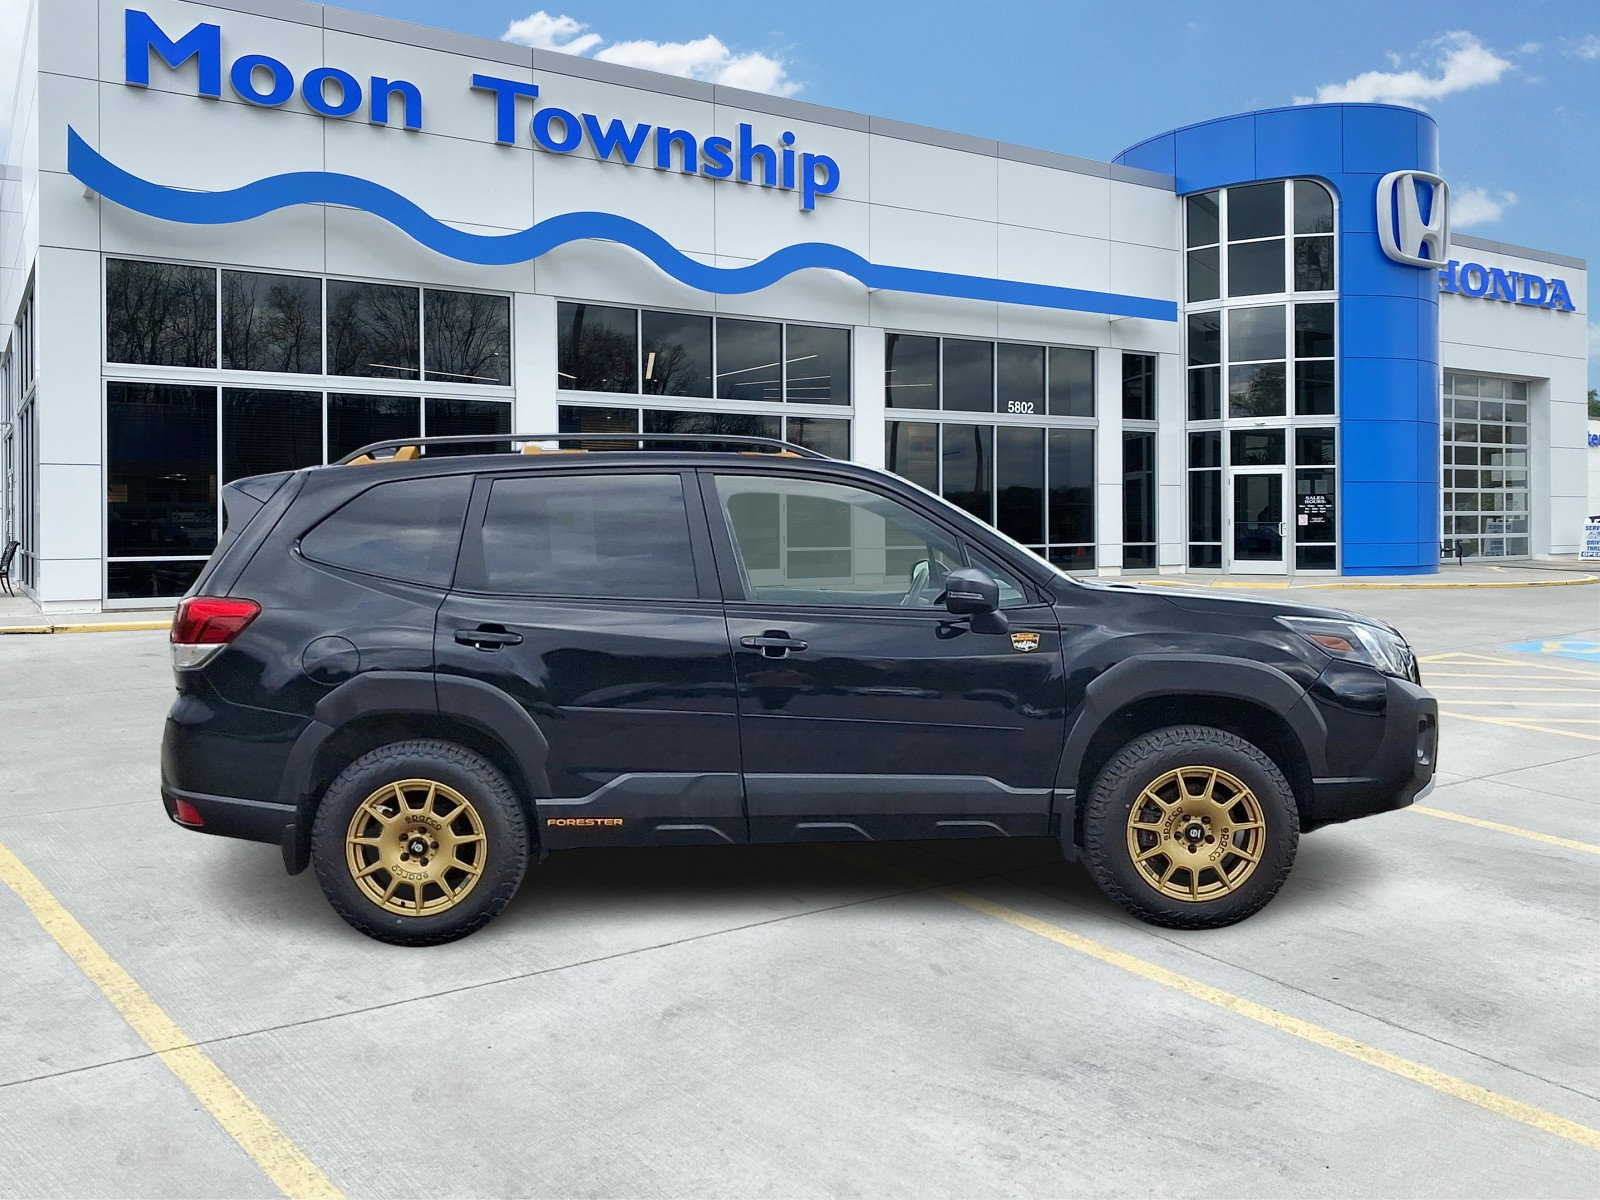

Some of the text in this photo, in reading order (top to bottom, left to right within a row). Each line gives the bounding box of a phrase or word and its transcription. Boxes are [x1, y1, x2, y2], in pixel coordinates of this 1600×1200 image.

[125, 9, 840, 212] Moon Township
[1438, 260, 1576, 312] HONDA
[1007, 400, 1034, 414] 5802
[546, 818, 624, 827] FORESTER
